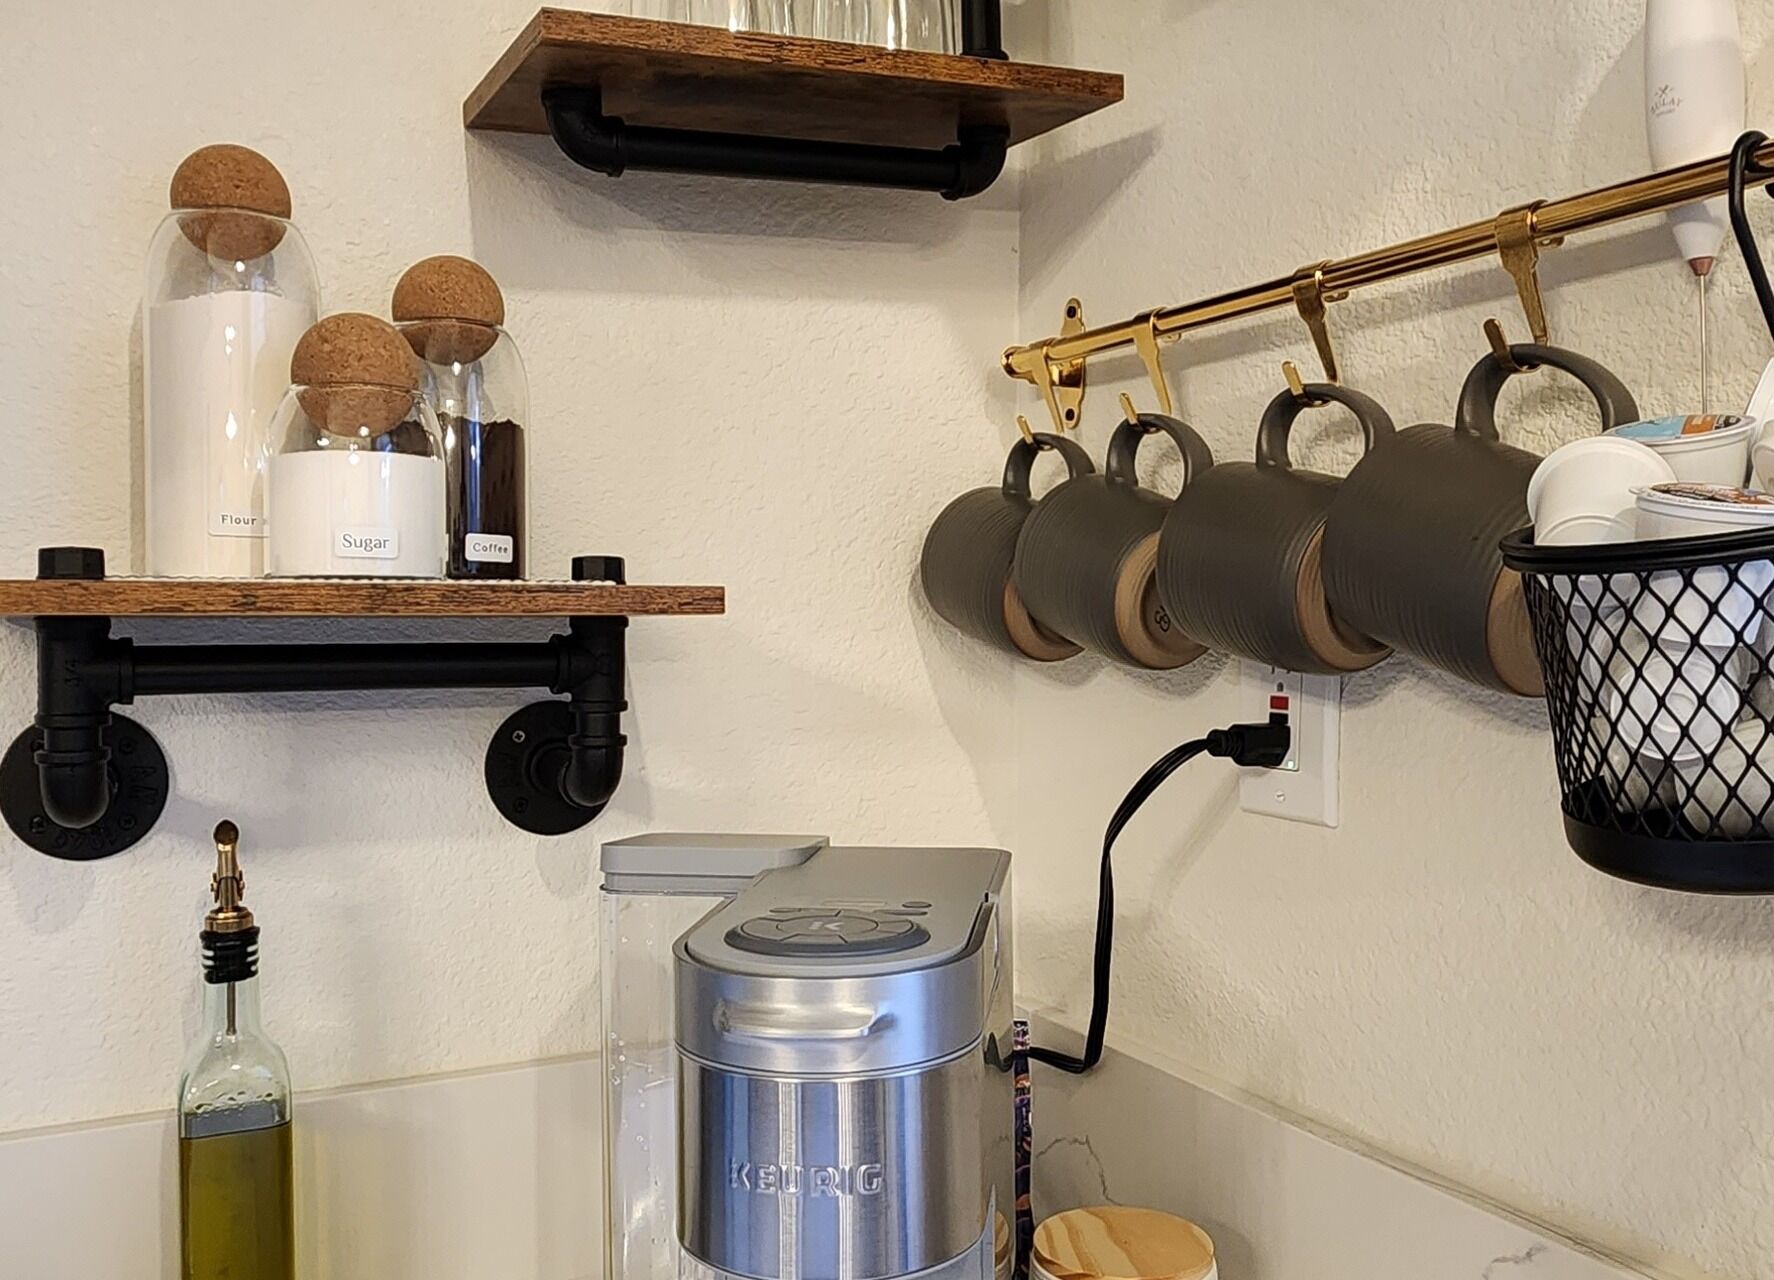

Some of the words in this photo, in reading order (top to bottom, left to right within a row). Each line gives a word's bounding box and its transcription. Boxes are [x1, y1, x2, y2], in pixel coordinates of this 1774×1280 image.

[220, 514, 257, 526] Flour
[342, 533, 390, 552] Sugar
[472, 542, 508, 554] Coffee
[730, 1158, 882, 1197] KEURIG
